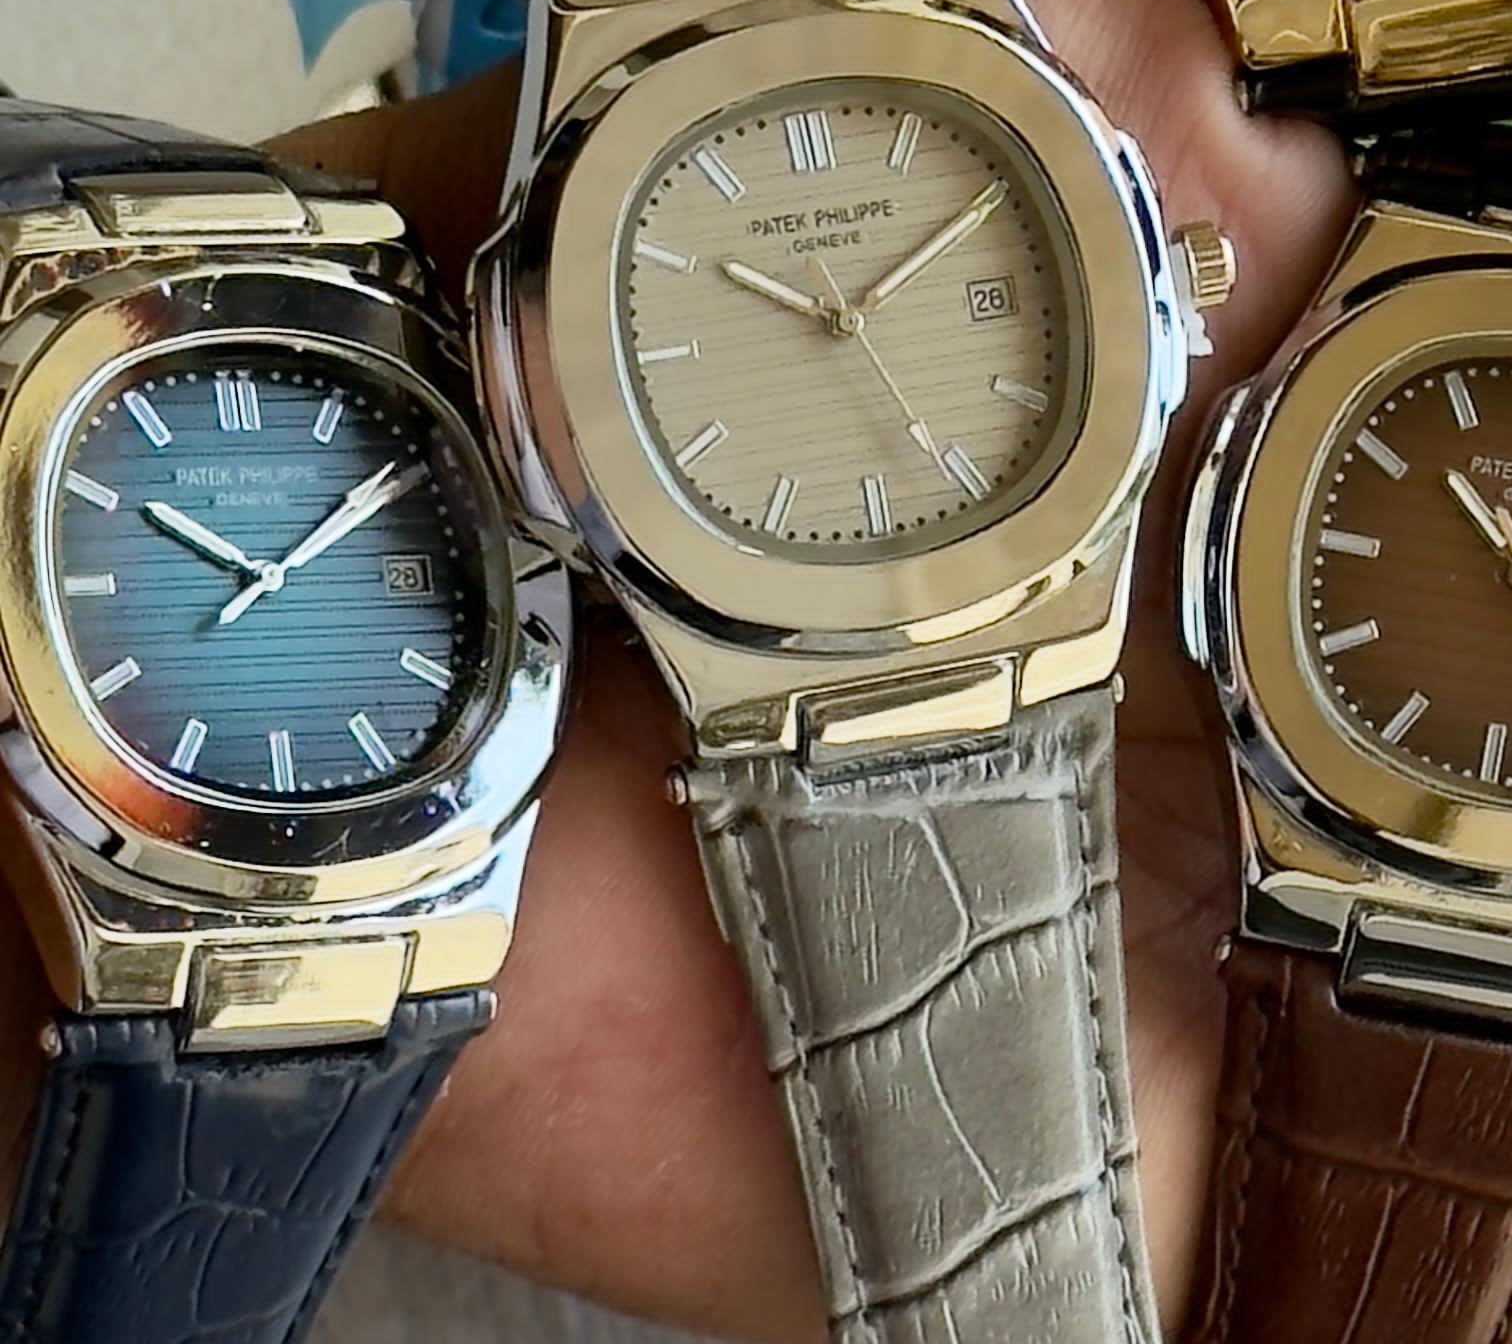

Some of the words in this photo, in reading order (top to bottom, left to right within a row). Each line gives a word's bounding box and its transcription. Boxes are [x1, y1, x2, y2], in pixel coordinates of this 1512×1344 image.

[751, 213, 806, 236] PATEK
[814, 199, 895, 228] PHILIPPE
[793, 230, 861, 253] GENEVE
[973, 288, 1006, 312] 28
[175, 467, 233, 487] PATEK
[387, 567, 419, 588] 28
